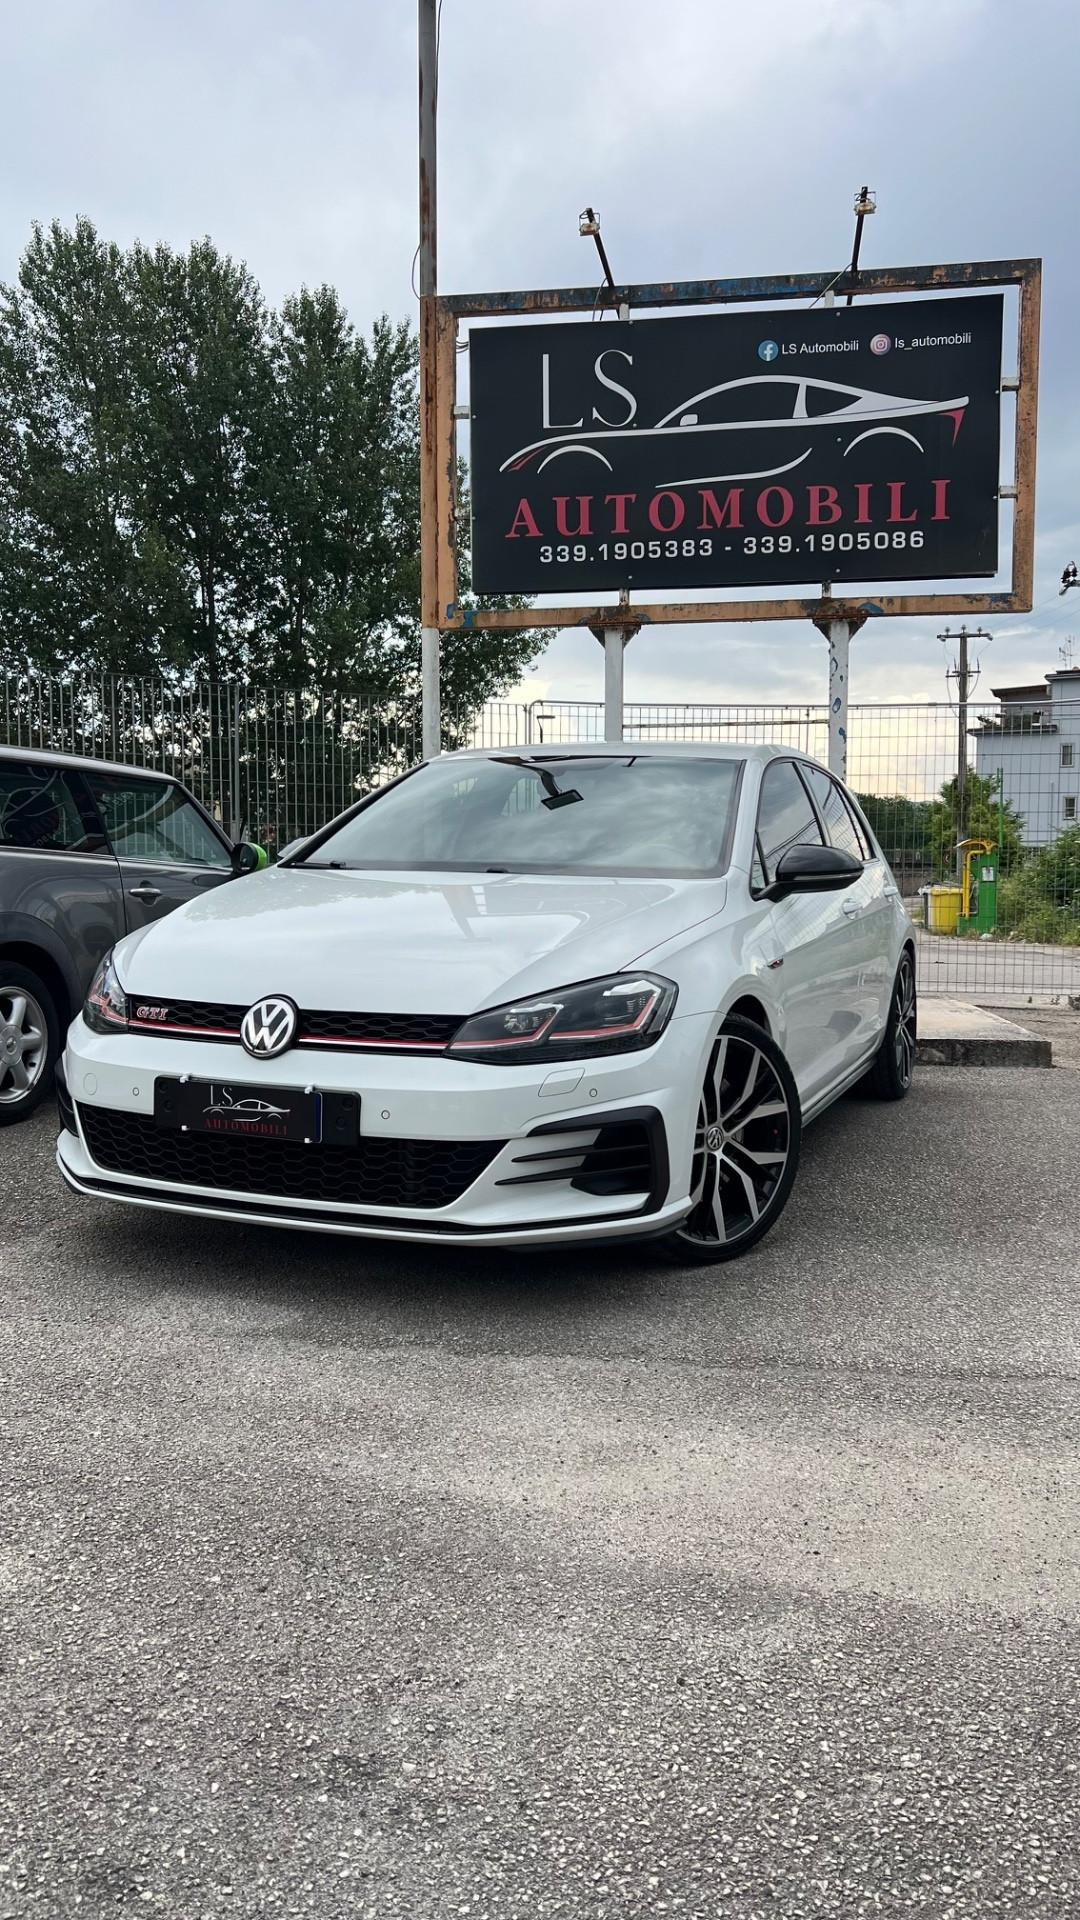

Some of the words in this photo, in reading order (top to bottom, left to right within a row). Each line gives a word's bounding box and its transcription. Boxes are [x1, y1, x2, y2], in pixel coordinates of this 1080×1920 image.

[782, 341, 797, 354] LS
[800, 340, 859, 354] Automobili
[542, 348, 638, 430] LS
[505, 479, 951, 538] AUTOMOBILI
[539, 538, 713, 563] 339.1905383
[743, 530, 925, 555] 339.1905086
[136, 1006, 168, 1021] GTI
[210, 1084, 233, 1106] LS
[205, 1119, 288, 1135] AUTOMOBILI
